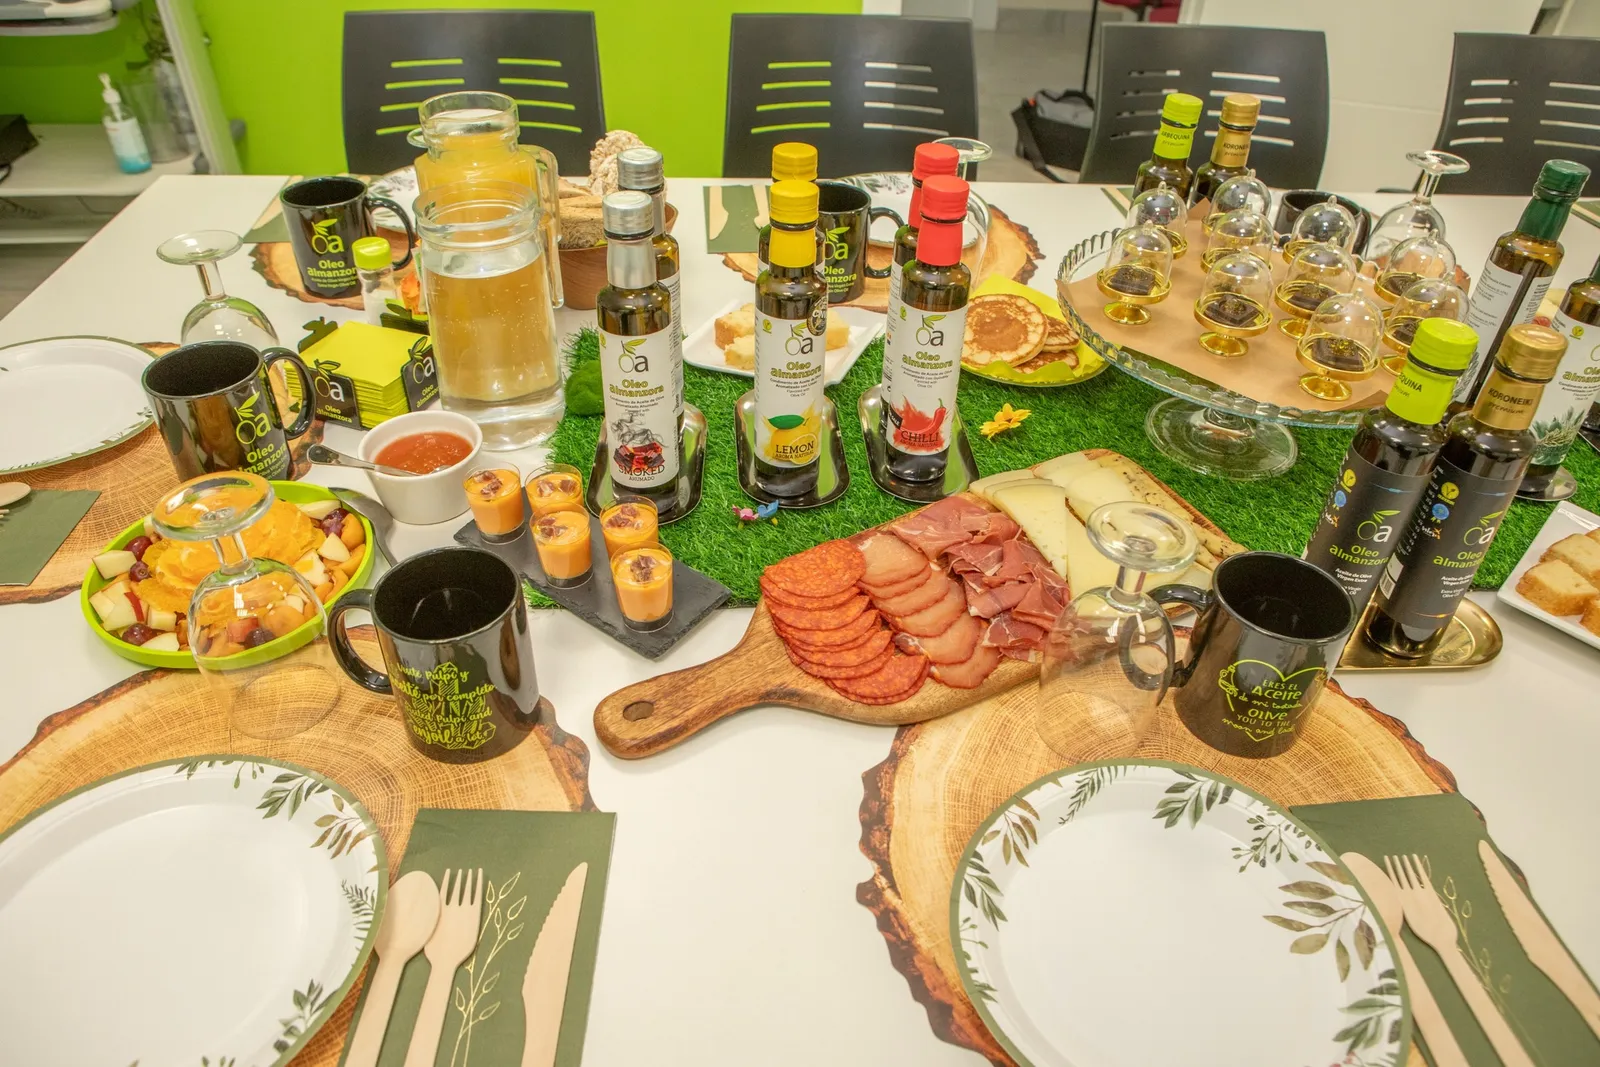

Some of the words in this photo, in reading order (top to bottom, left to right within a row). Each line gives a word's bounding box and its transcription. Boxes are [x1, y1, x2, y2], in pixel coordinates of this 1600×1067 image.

[318, 259, 345, 270] Oleo
[307, 266, 357, 278] almanzor
[826, 273, 857, 283] anzora
[901, 353, 954, 370] almanzora
[915, 351, 941, 361] Oleo
[770, 364, 822, 379] almanzora
[786, 361, 812, 371] Oleo
[621, 378, 649, 389] Oleo
[1399, 371, 1422, 393] EQUINA
[421, 384, 434, 396] Oleo
[609, 383, 665, 398] almanzora
[316, 407, 353, 423] almanzora
[324, 404, 342, 414] Oleo
[246, 443, 275, 463] Oleo
[775, 440, 814, 454] LEMON
[618, 464, 665, 477] SMOKED
[1351, 545, 1380, 557] Oleo
[1263, 679, 1285, 690] ERES
[1288, 683, 1298, 691] EL
[1237, 714, 1257, 725] YOU
